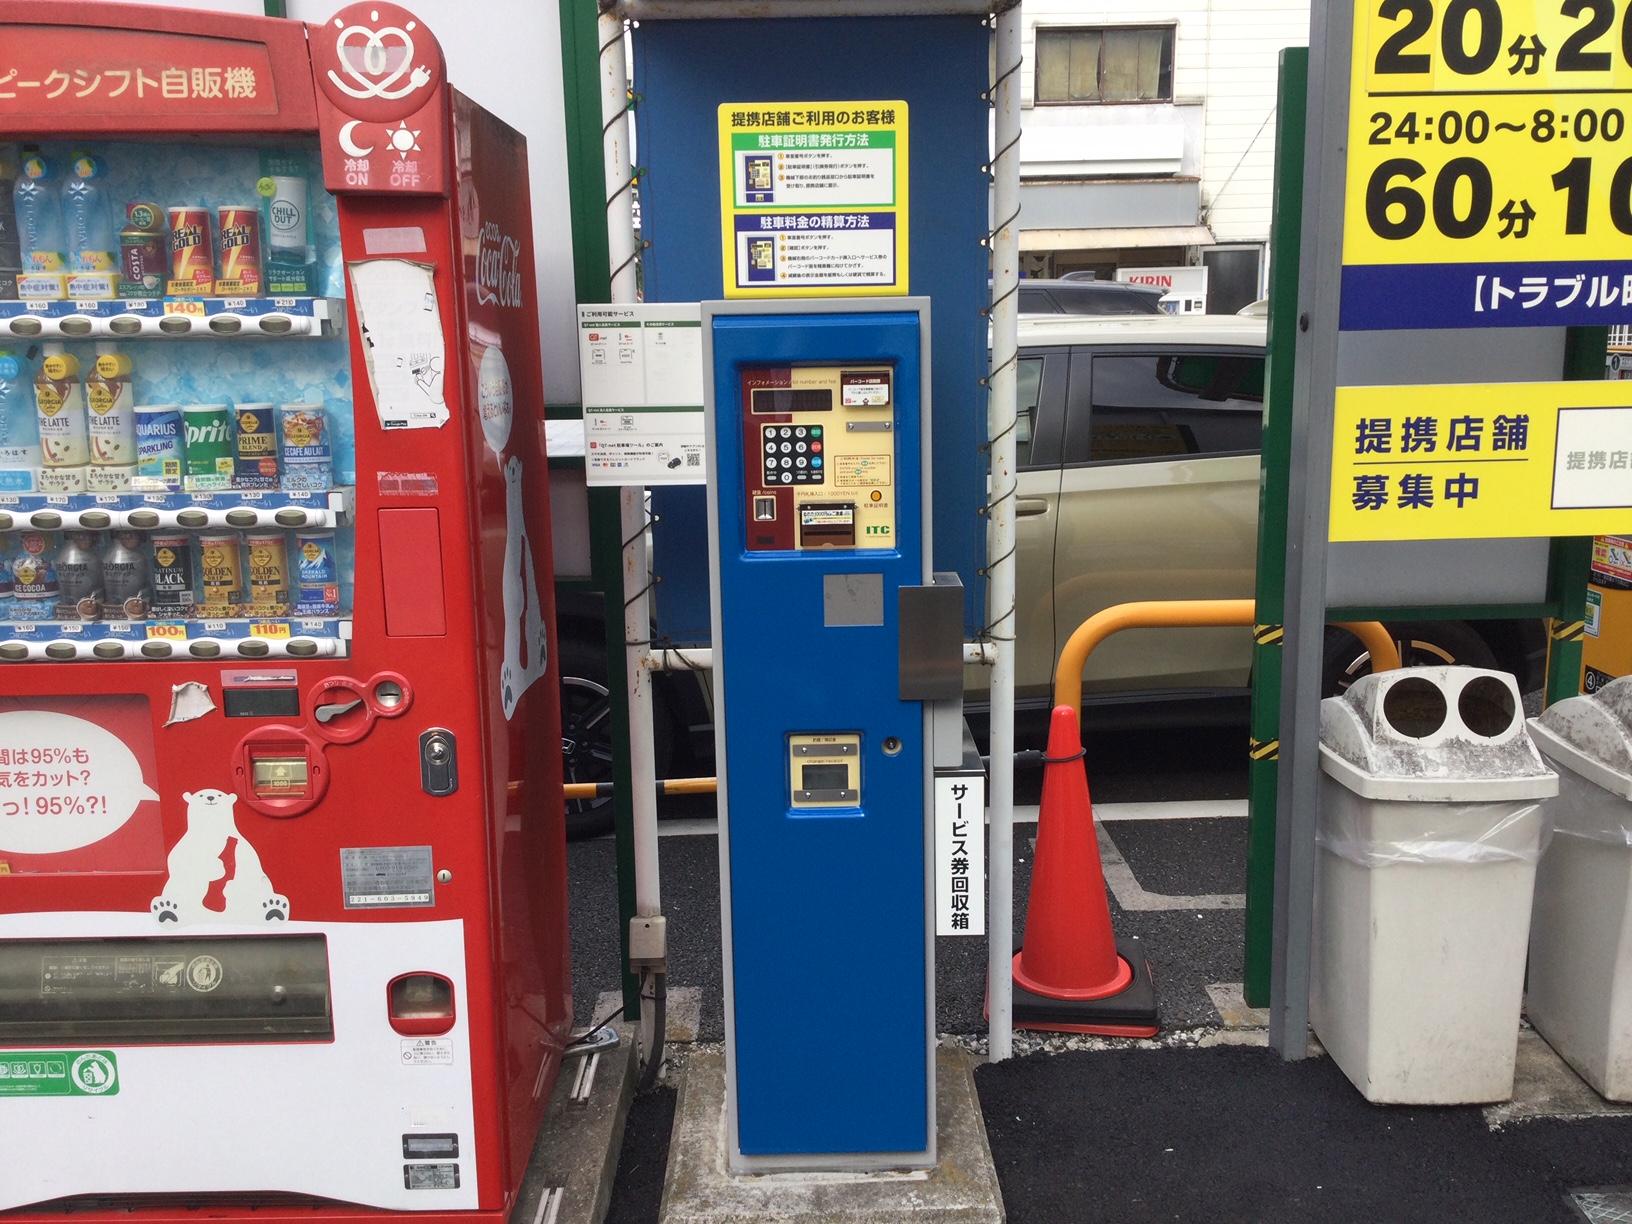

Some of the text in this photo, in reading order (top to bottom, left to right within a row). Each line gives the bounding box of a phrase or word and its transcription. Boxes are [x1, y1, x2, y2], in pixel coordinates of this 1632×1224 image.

[1555, 0, 1632, 72] 2
[731, 109, 896, 127] 提携店舗ご利用のお客様
[758, 133, 870, 148] 駐車証明書発行方法
[344, 158, 370, 173] 冷却
[392, 160, 419, 174] 冷却
[345, 172, 369, 186] ON
[390, 173, 421, 187] OFF
[1365, 156, 1537, 241] 60分
[272, 206, 296, 217] CHILL
[274, 214, 292, 224] OUT
[760, 215, 870, 230] 駐車料金の精算方法
[172, 233, 201, 251] GOLD
[221, 233, 250, 251] GOLD
[130, 248, 141, 281] COSTA
[1128, 274, 1173, 288] KIRIN
[136, 423, 176, 436] QUARIUS
[1355, 414, 1530, 455] 提携店舗
[1566, 450, 1632, 471] 提携店
[1352, 473, 1480, 511] 募集中
[866, 525, 890, 535] ITC
[950, 784, 970, 931] サービス券回収箱
